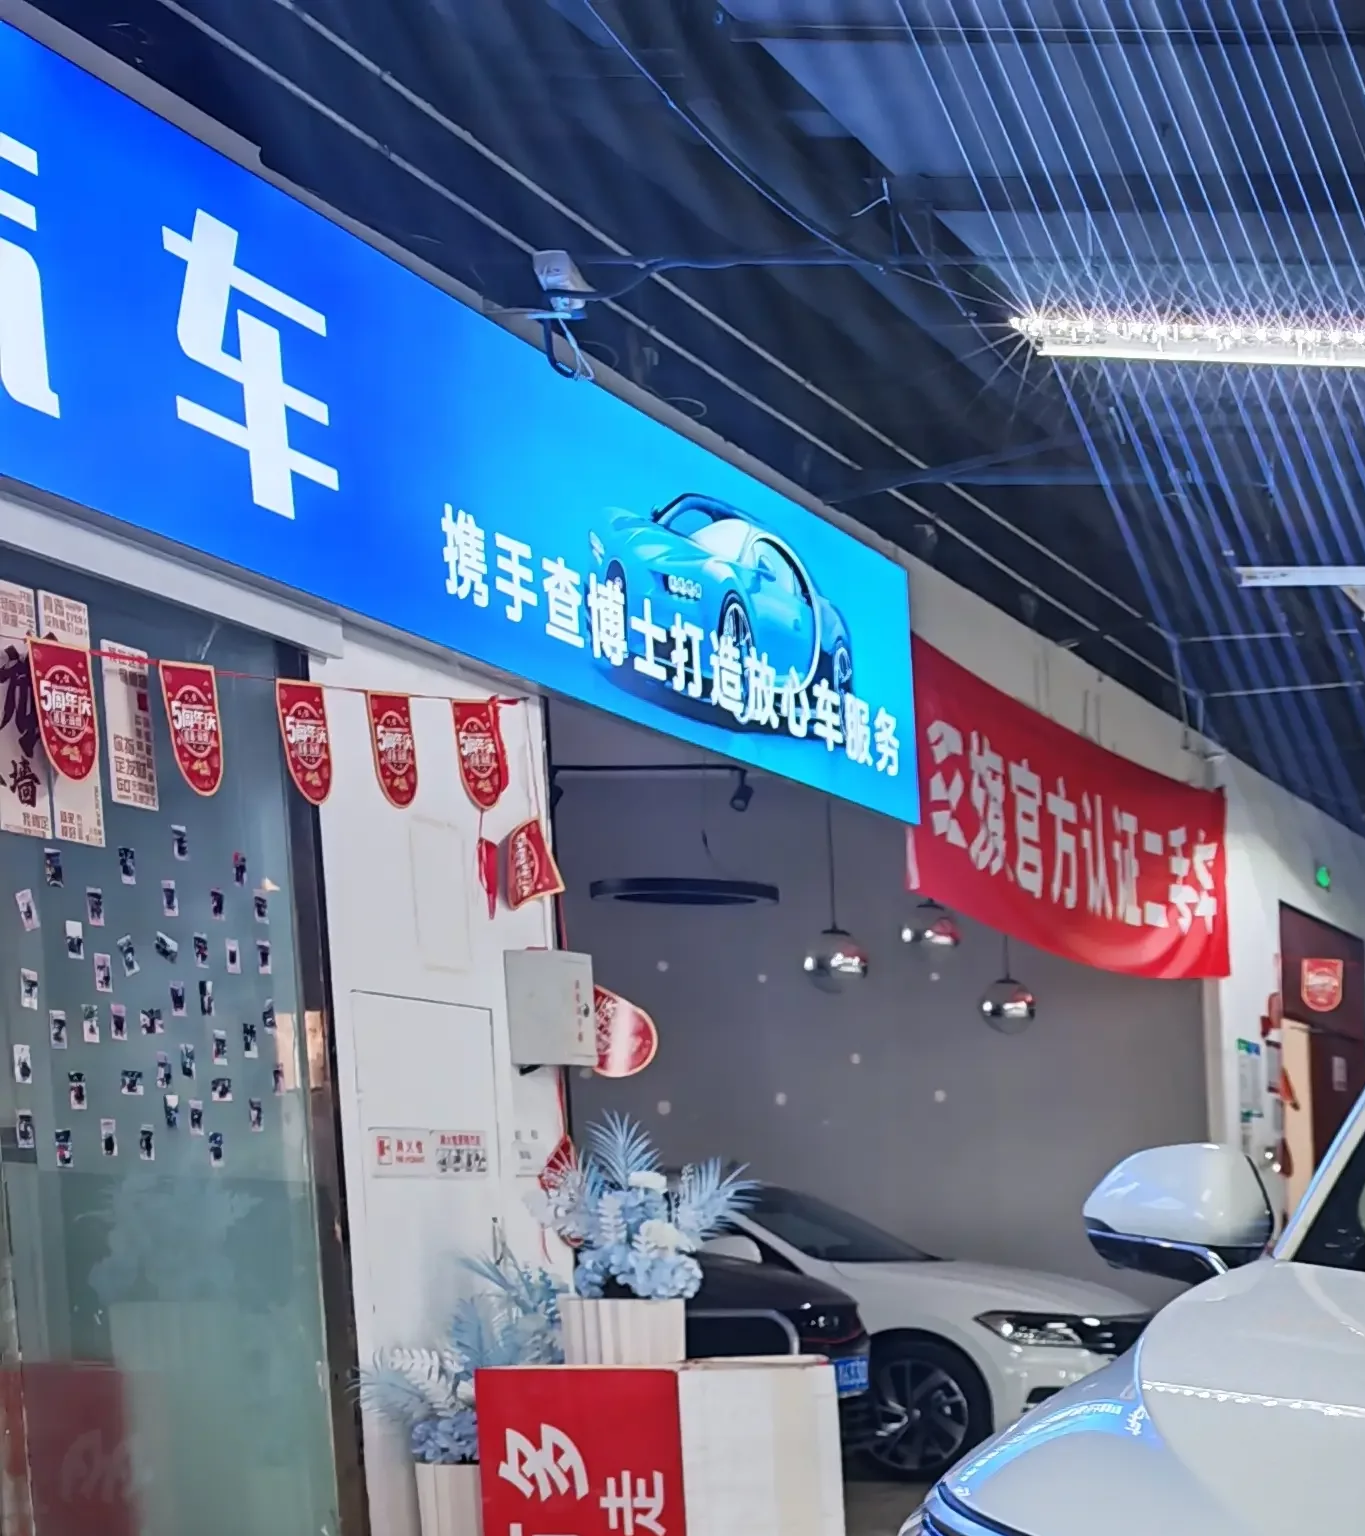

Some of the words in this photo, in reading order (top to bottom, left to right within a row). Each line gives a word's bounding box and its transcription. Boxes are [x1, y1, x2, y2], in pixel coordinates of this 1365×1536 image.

[441, 503, 900, 776] 携手查博士打造放心车服务
